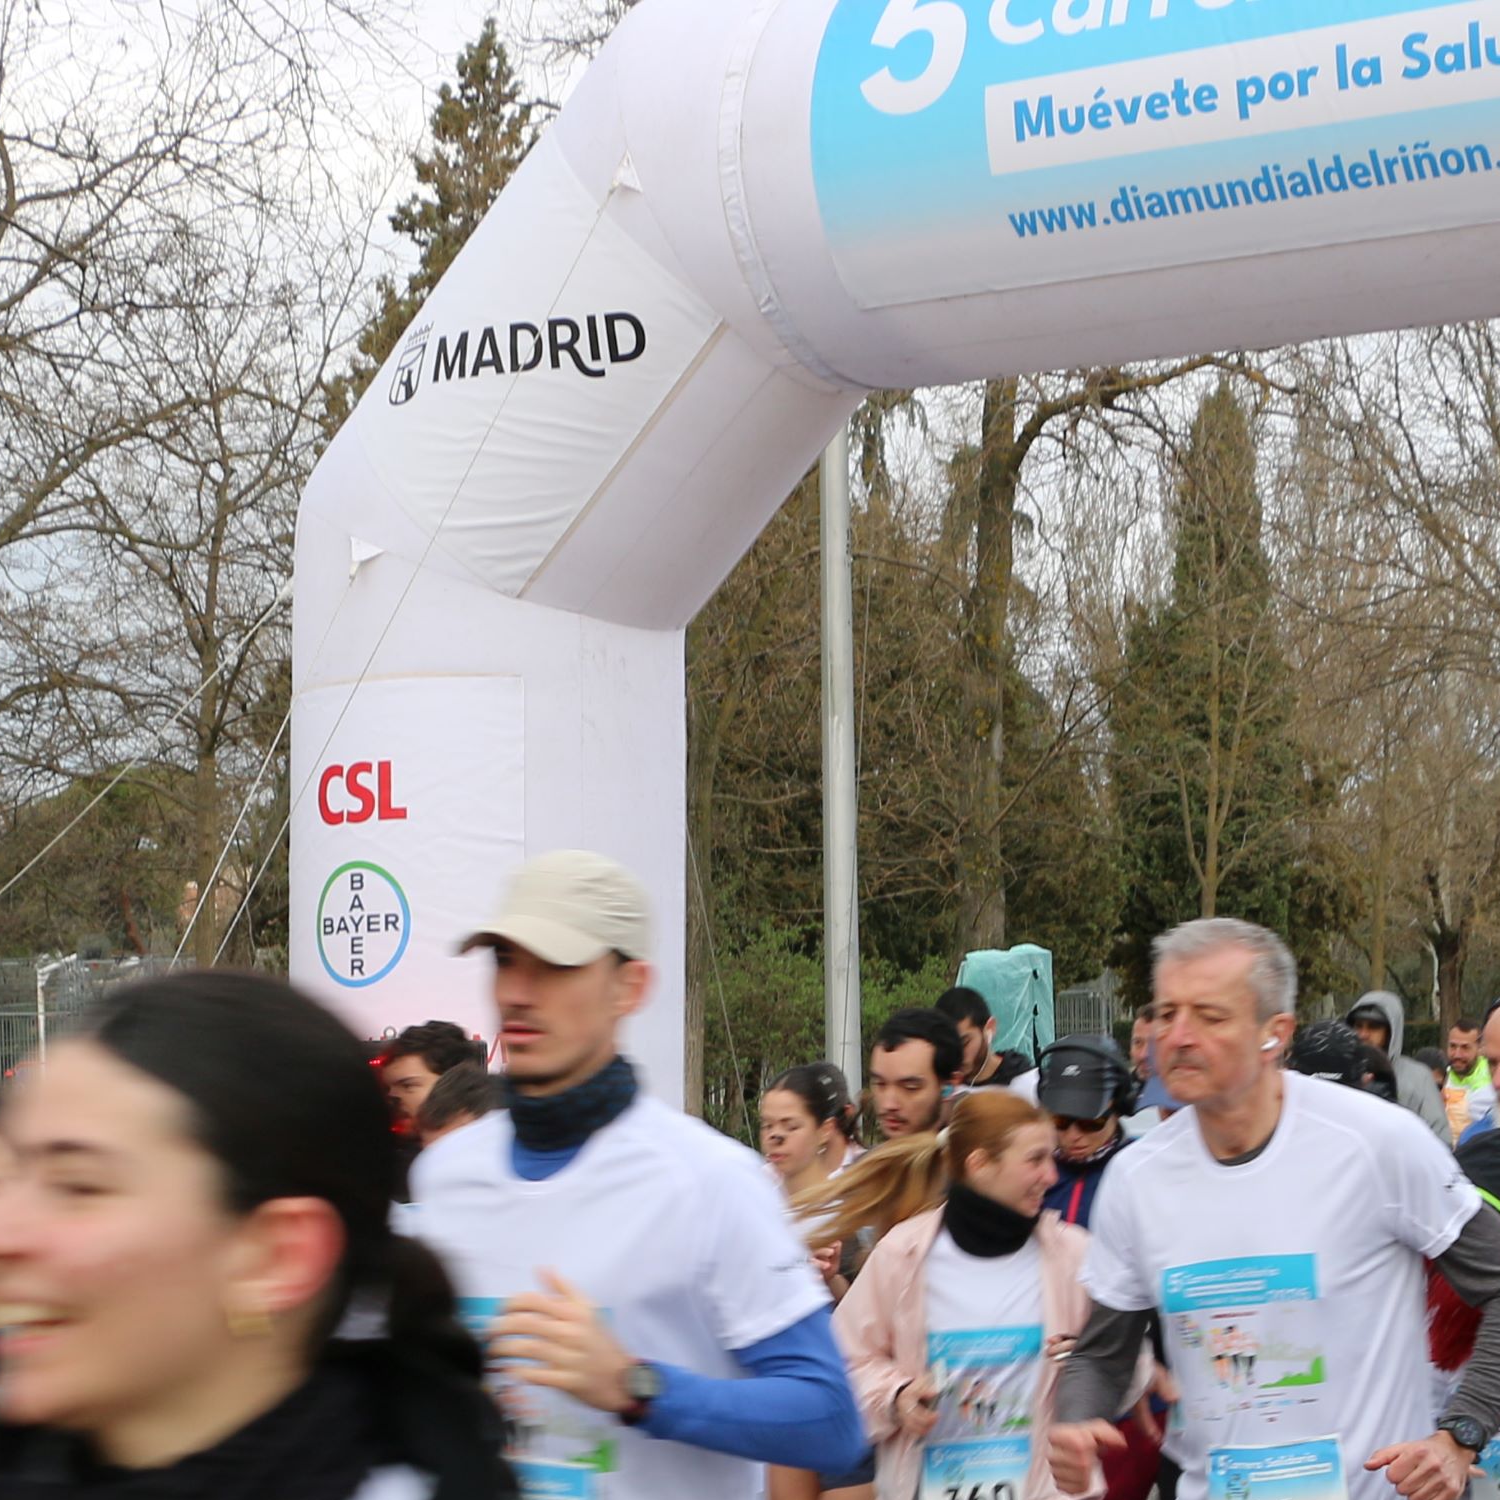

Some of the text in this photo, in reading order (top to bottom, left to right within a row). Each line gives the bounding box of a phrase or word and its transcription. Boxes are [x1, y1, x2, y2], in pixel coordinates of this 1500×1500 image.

[1013, 77, 1220, 143] Muévete
[1235, 65, 1320, 120] por
[1335, 43, 1383, 91] la
[432, 311, 647, 384] MADRID
[317, 759, 408, 826] CSL
[322, 913, 400, 937] BAYER
[349, 872, 365, 978] BAYER
